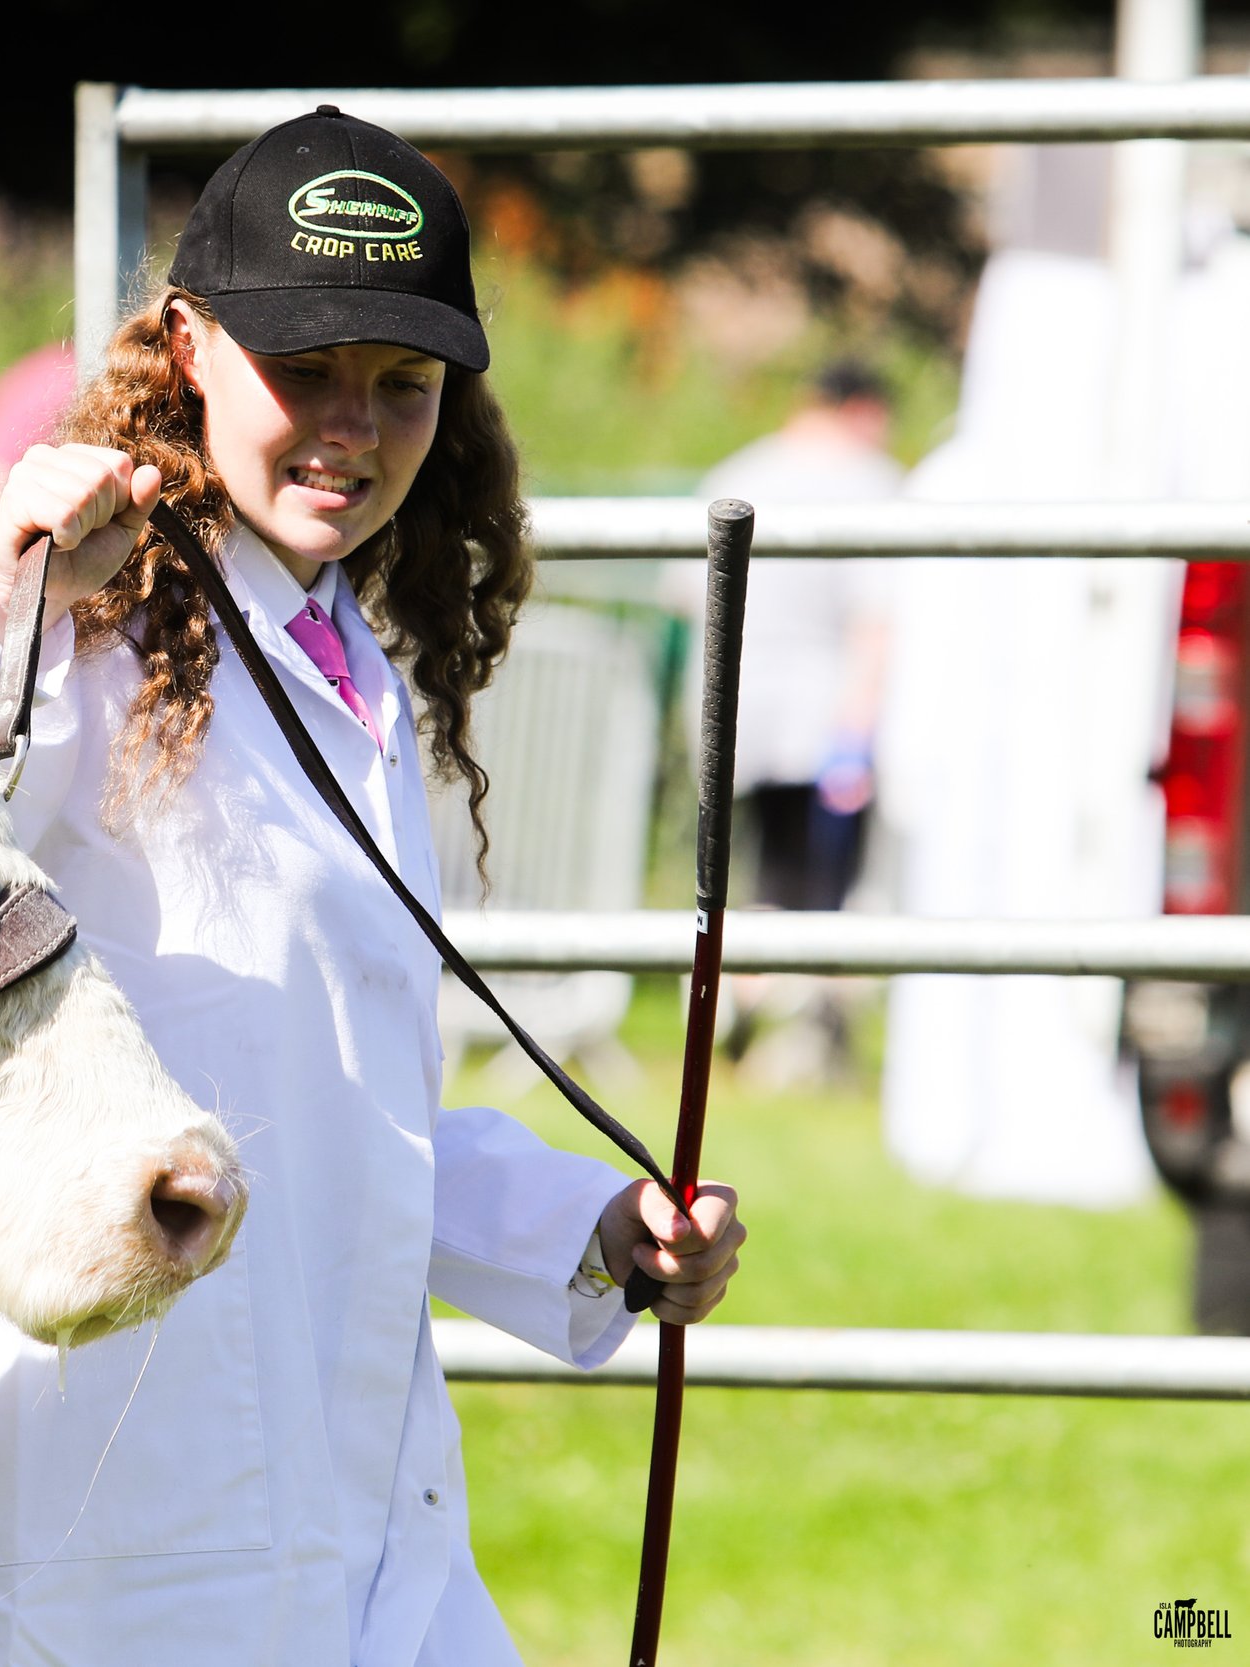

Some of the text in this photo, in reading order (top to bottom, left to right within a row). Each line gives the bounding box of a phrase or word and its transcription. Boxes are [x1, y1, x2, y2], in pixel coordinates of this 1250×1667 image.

[296, 188, 418, 224] SHERRIFF
[291, 231, 423, 262] CROP CARE
